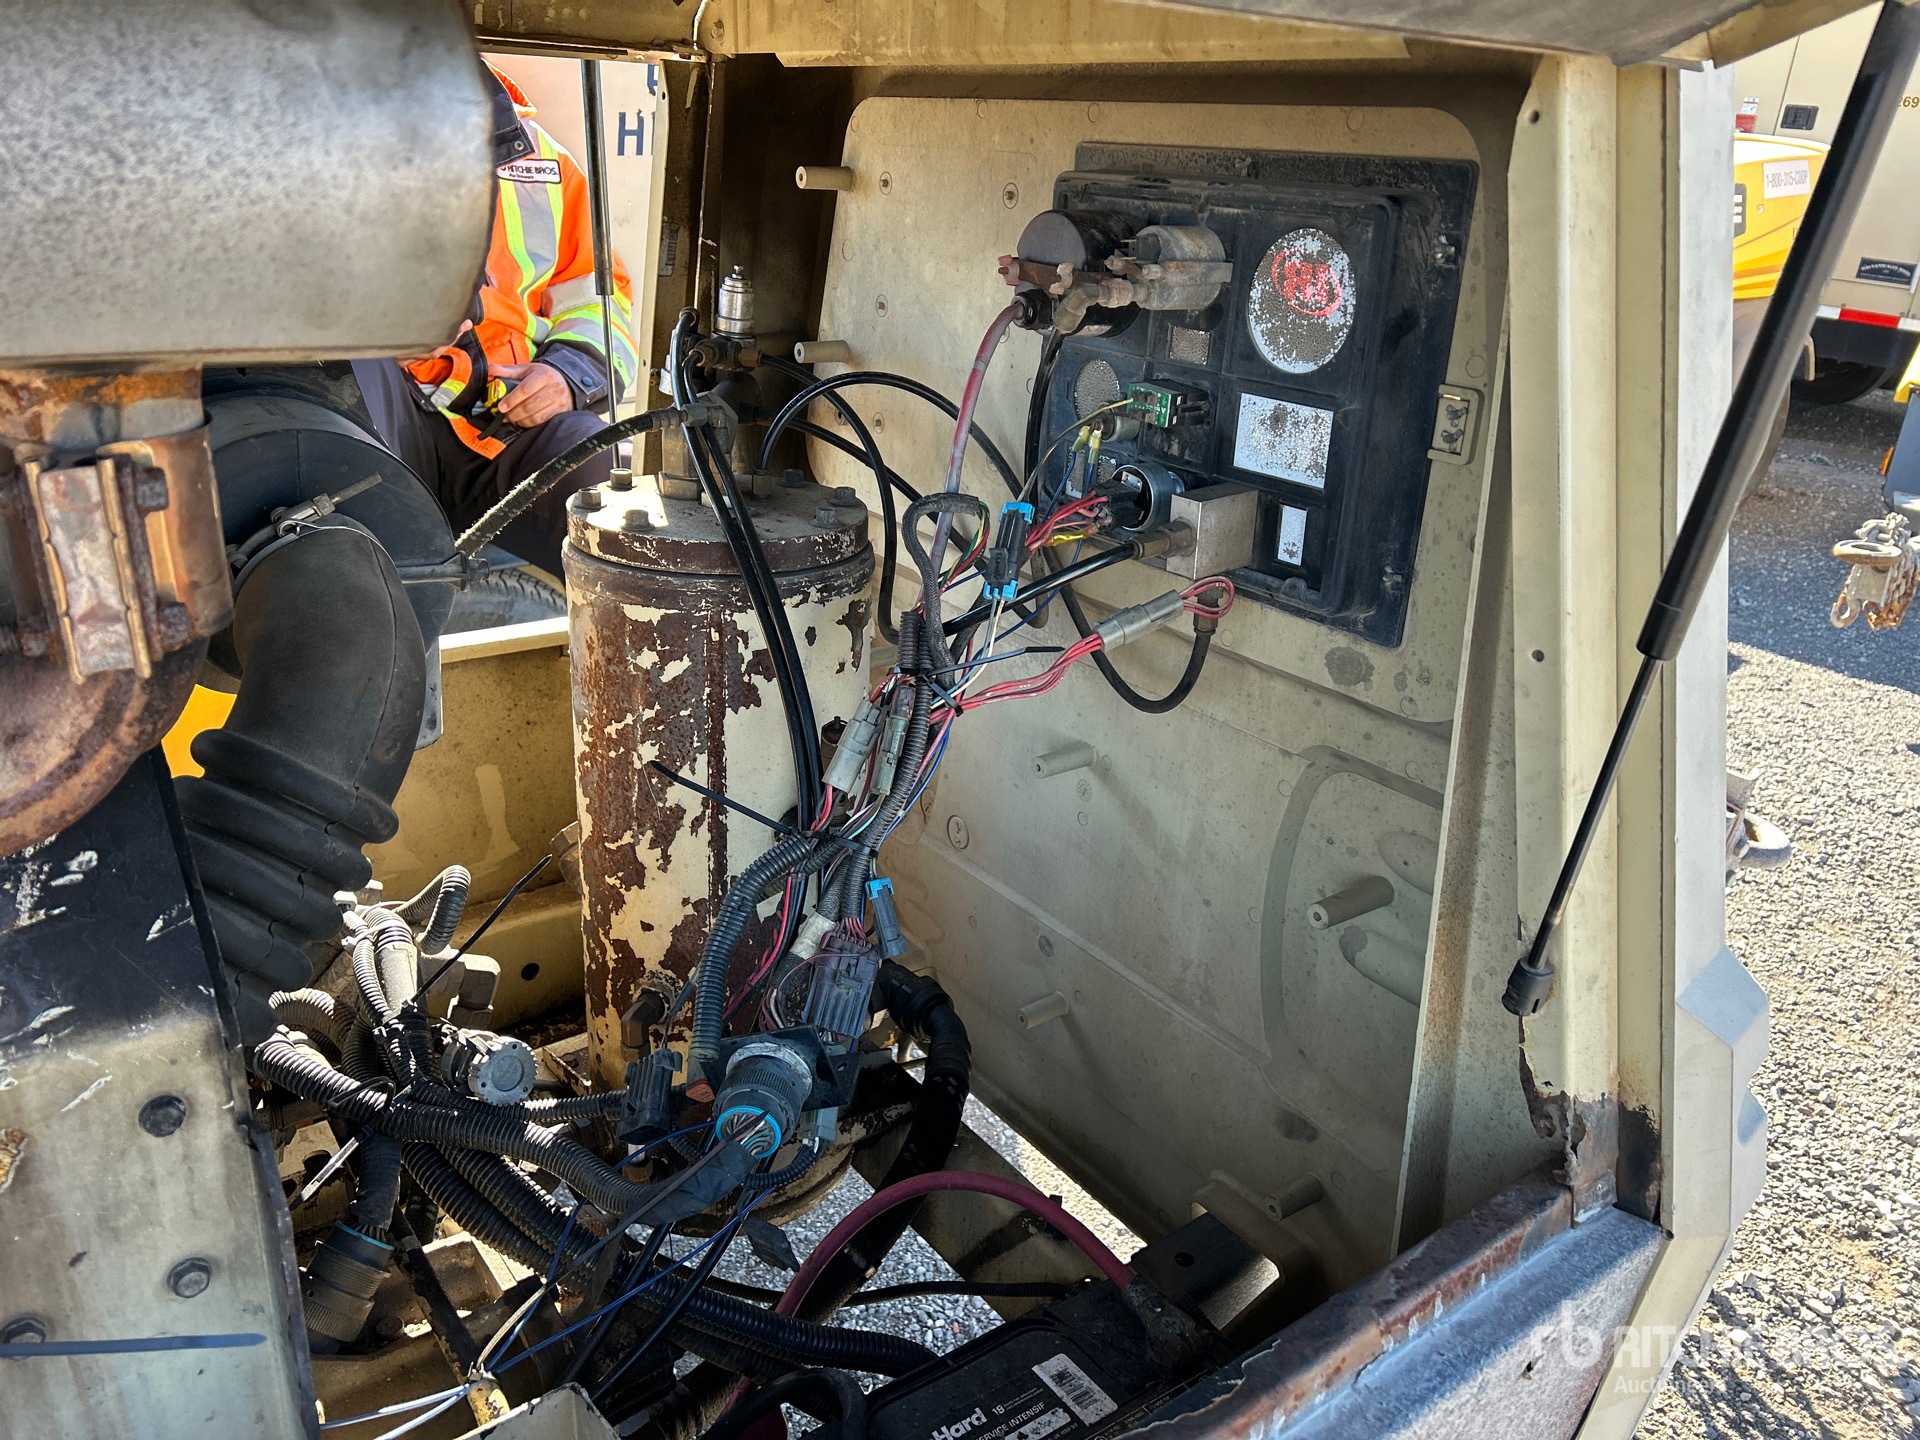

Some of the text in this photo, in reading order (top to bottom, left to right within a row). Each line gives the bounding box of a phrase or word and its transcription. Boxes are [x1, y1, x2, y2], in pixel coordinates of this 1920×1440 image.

[617, 111, 655, 156] H
[930, 1404, 1006, 1440] Hard 18
[1009, 1401, 1046, 1428] INTENSIF
